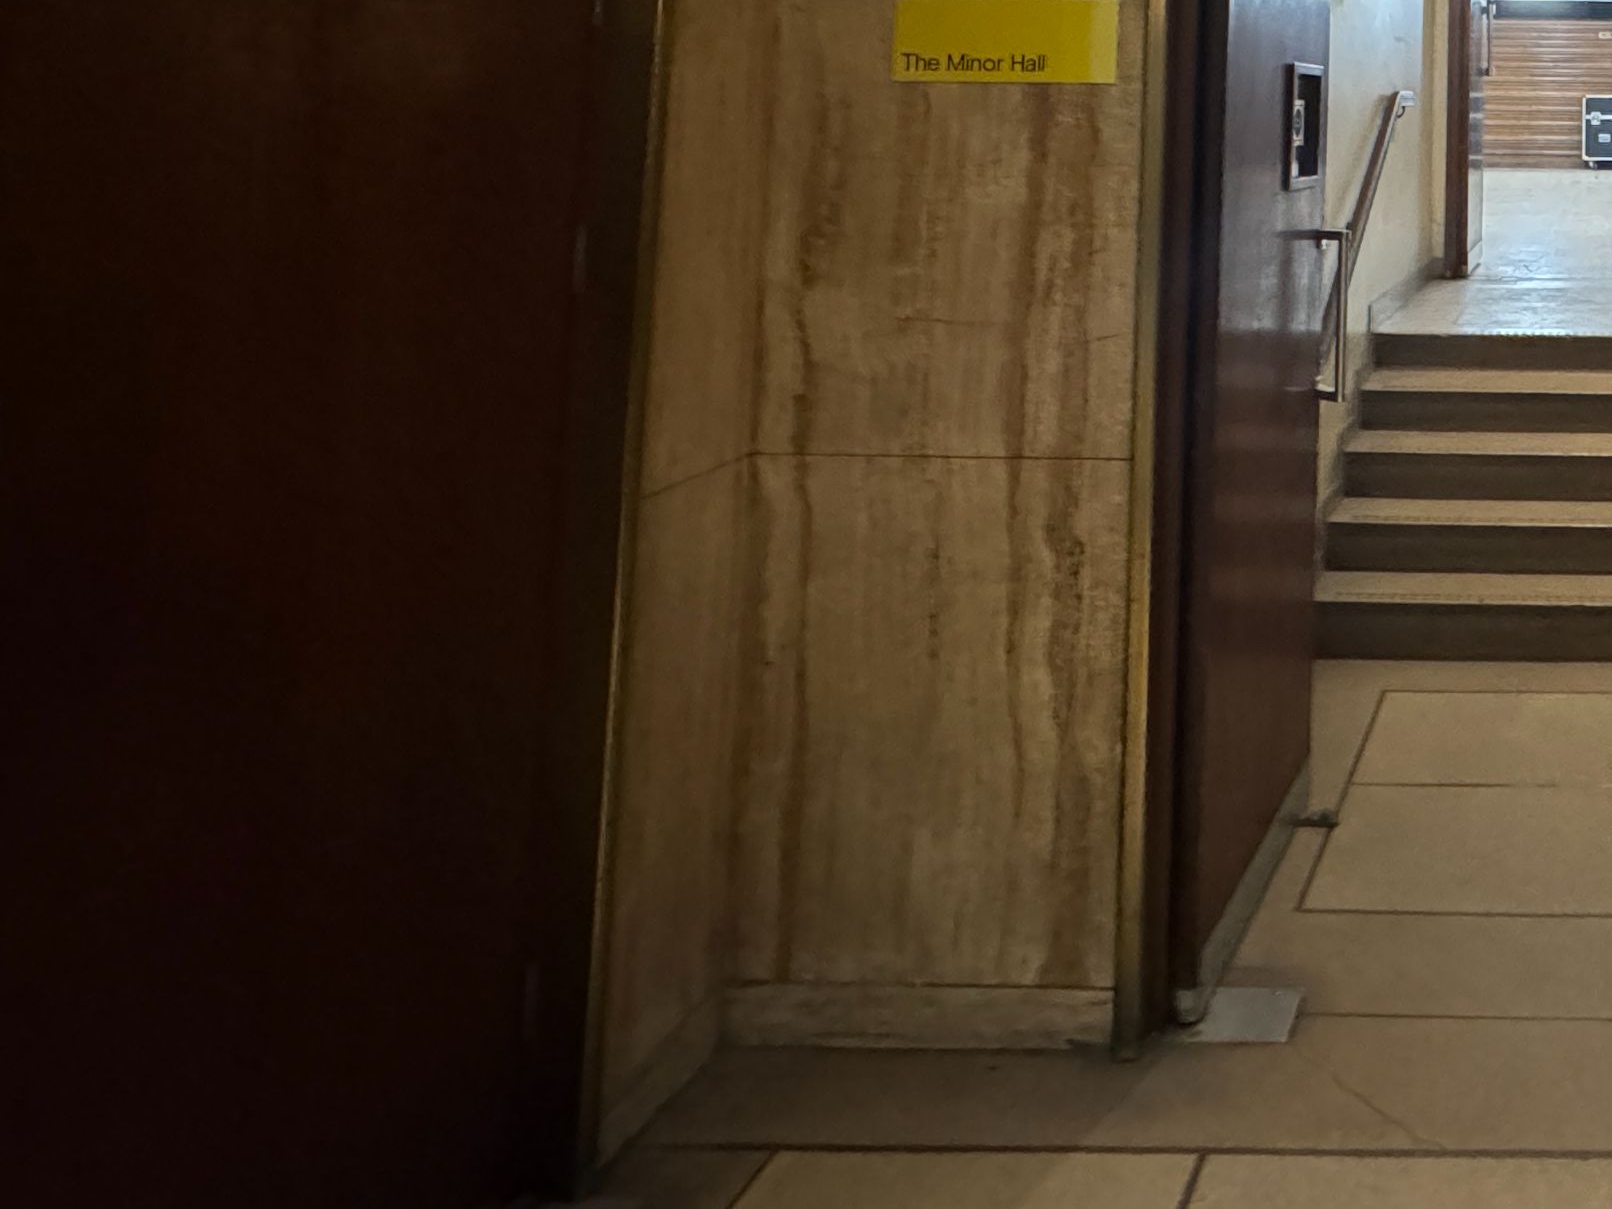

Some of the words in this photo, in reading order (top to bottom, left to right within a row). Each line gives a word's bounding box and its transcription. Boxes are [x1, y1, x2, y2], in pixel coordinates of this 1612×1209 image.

[900, 52, 941, 72] The
[946, 53, 1004, 72] Minor
[1010, 54, 1047, 73] Hall
